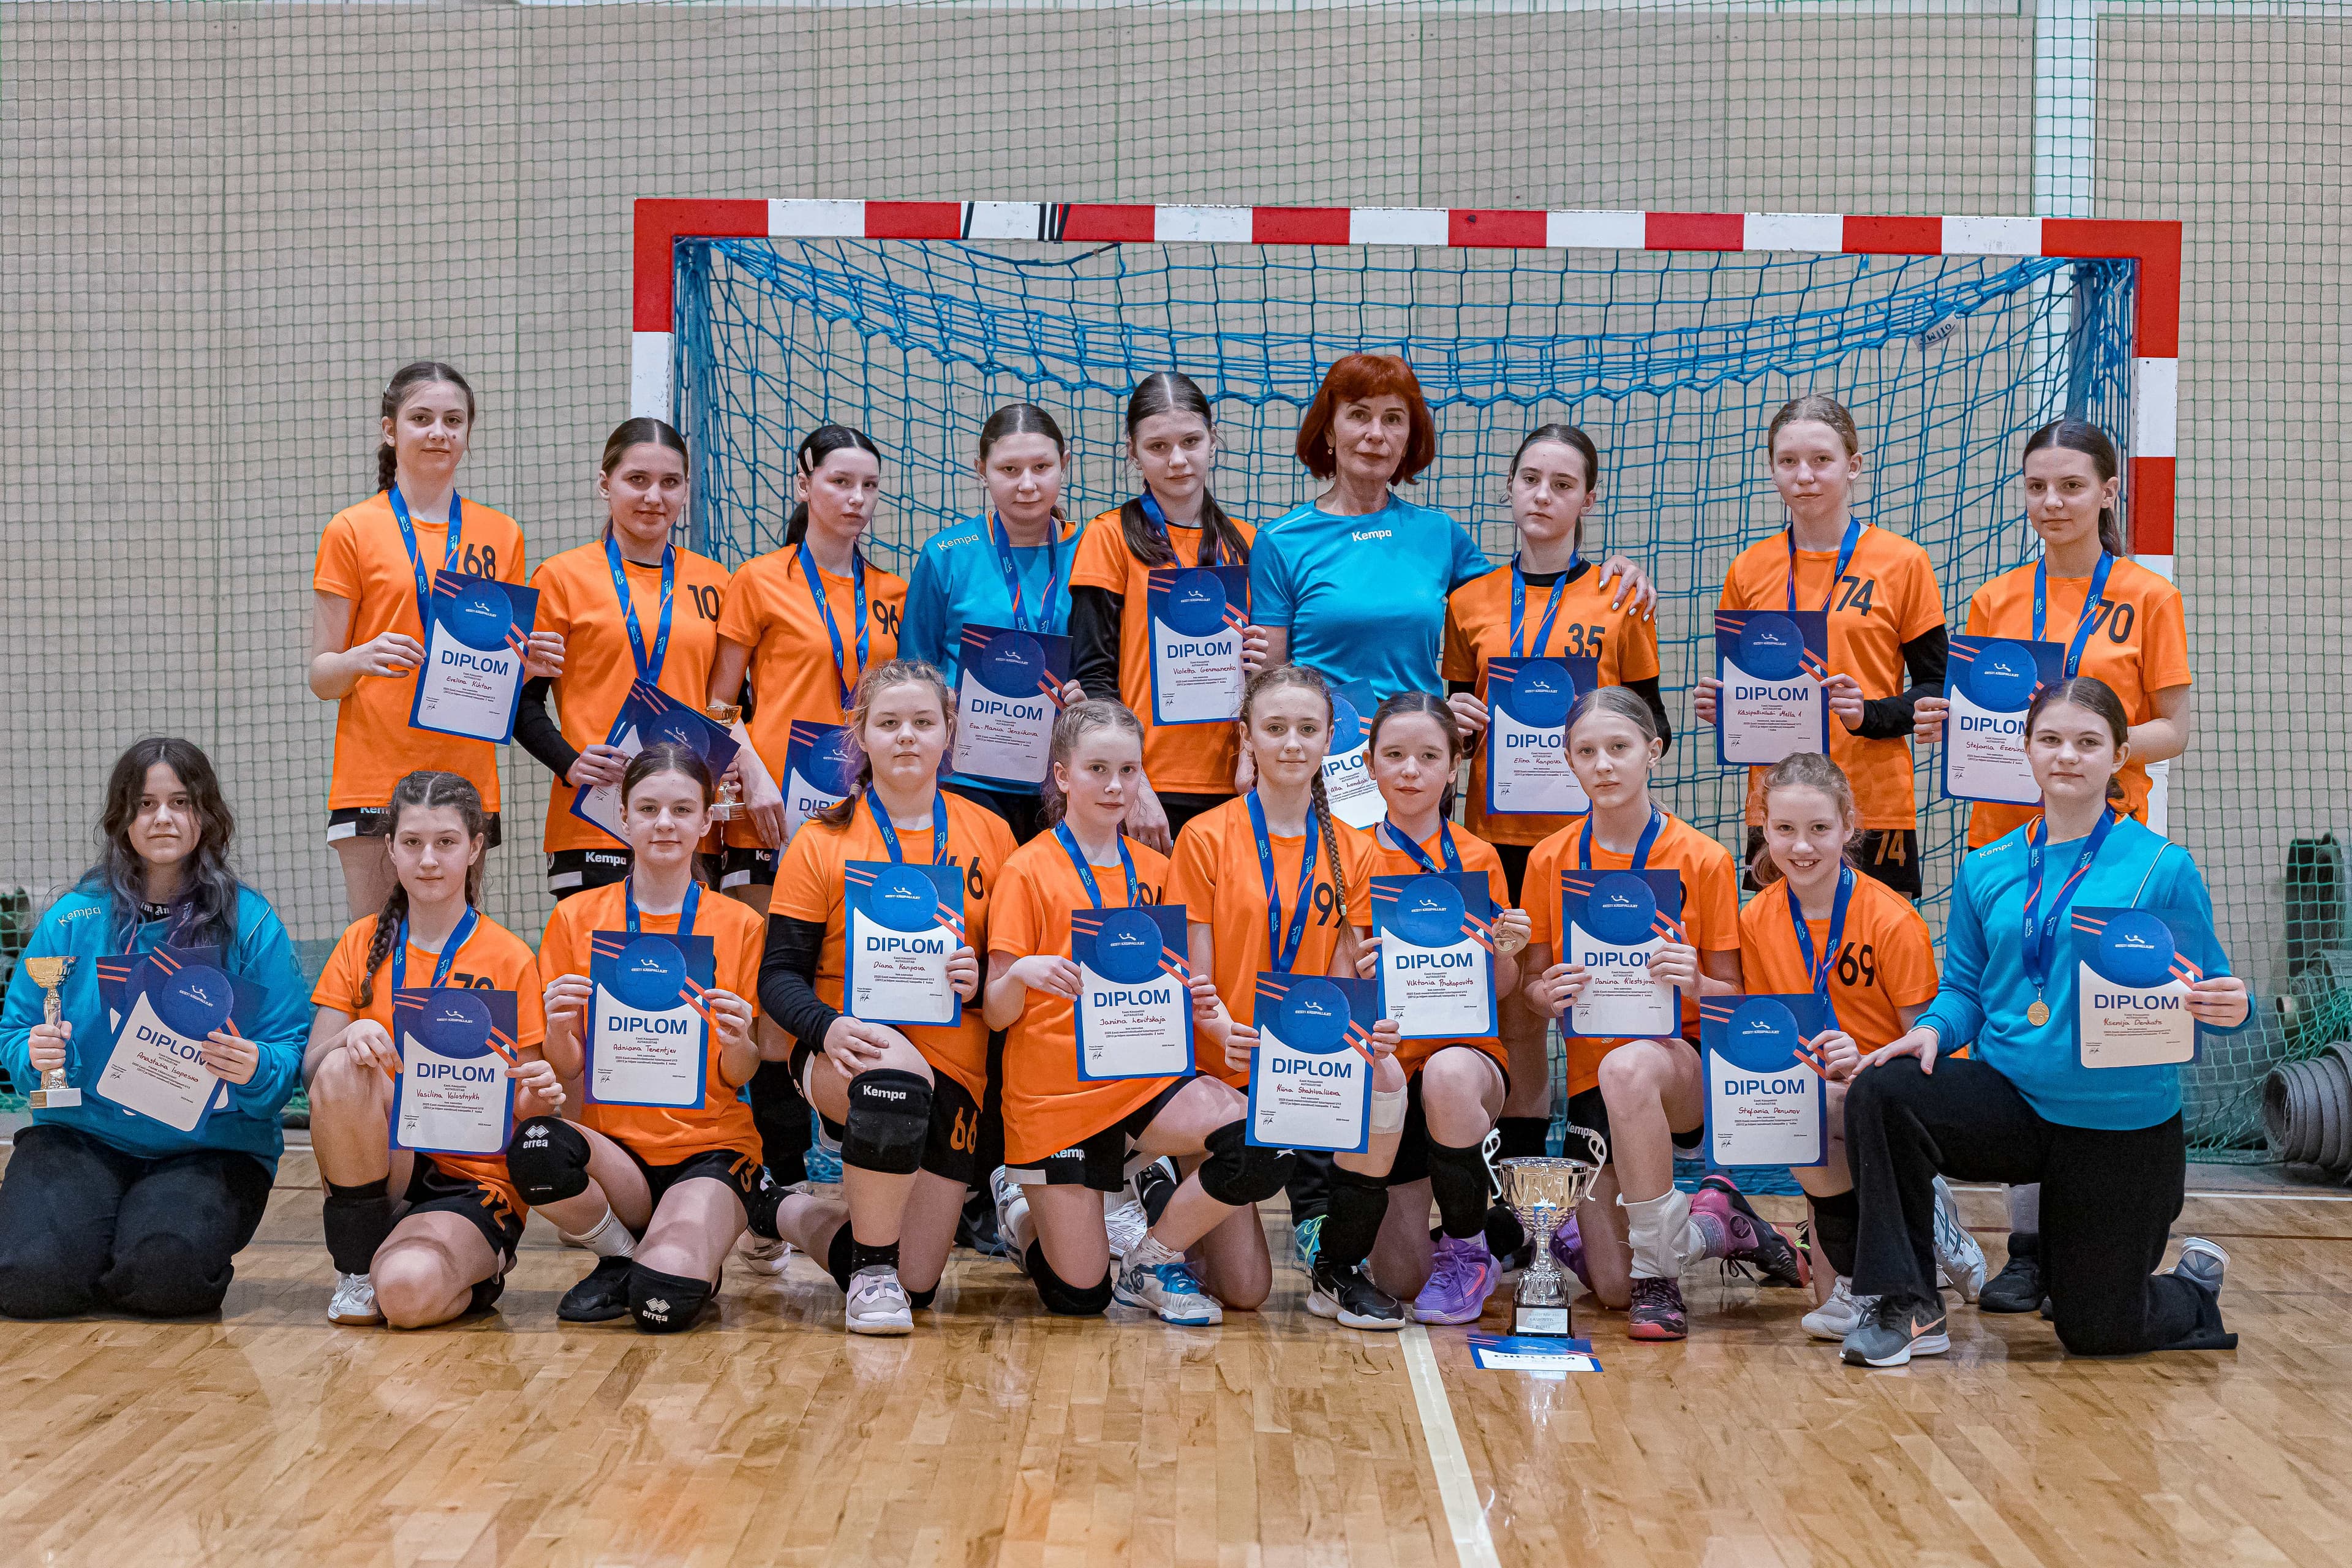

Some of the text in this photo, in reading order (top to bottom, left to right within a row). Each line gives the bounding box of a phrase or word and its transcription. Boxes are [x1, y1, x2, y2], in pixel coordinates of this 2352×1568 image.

[937, 533, 980, 552] Kempa
[1352, 530, 1392, 541] Kempa
[464, 544, 496, 579] 68
[687, 584, 720, 622] 10
[1836, 576, 1875, 616] 74
[873, 600, 900, 642] 96
[2090, 598, 2135, 644] 70
[1167, 641, 1232, 658] DIPLOM
[1564, 623, 1605, 663] 35
[441, 650, 509, 676] DIPLOM
[1735, 685, 1809, 701] DIPLOM
[971, 698, 1043, 721] DIPLOM
[1506, 734, 1566, 749] DIPLO
[1323, 755, 1364, 777] IPLO
[799, 797, 834, 811] DIP
[1874, 829, 1906, 866] 74
[1979, 841, 2013, 859] Kempa
[586, 851, 627, 866] Kempa
[58, 906, 102, 927] Kempa
[867, 936, 944, 954] DIPLOM
[1396, 952, 1473, 970] DIPLOM
[1838, 942, 1874, 987] 69
[1093, 989, 1170, 1008] DIPLOM
[2094, 994, 2179, 1010] DIPLOM
[608, 1016, 687, 1035] DIPLOM
[417, 1062, 495, 1083] DIPLOM
[1272, 1058, 1351, 1079] DIPLOM
[417, 1088, 443, 1098] Vasilina
[862, 1084, 907, 1101] Kempa
[1725, 1079, 1805, 1096] DIPLOM
[950, 1107, 978, 1154] 66
[1050, 1148, 1086, 1161] Kemp
